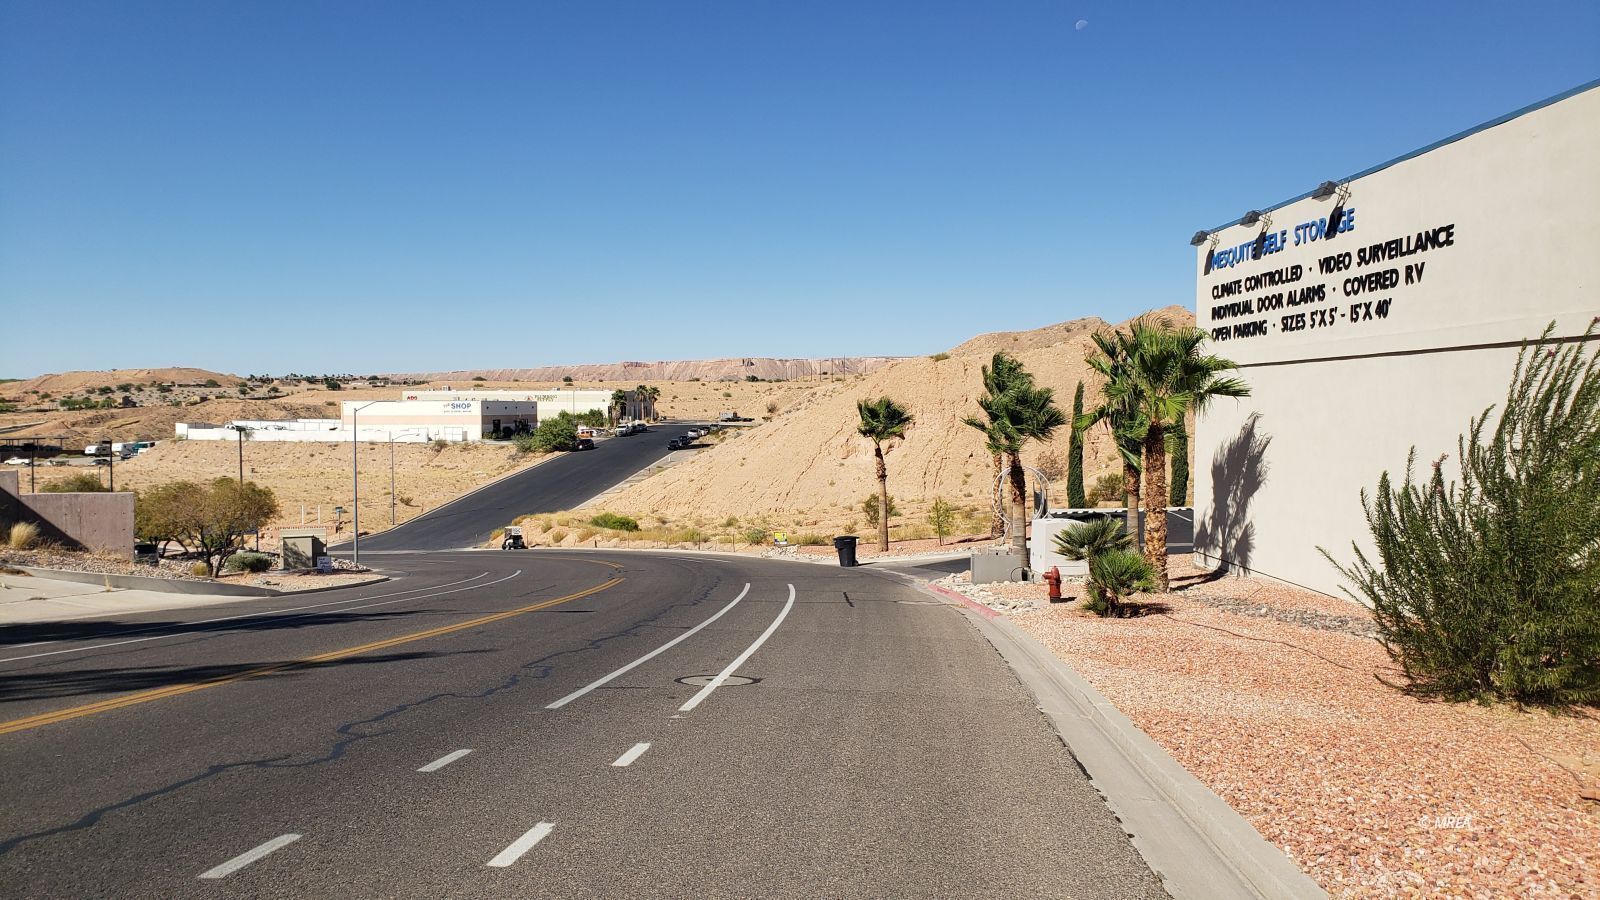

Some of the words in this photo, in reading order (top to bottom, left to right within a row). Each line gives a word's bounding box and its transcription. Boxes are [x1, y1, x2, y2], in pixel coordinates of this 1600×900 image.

[1212, 240, 1257, 271] MESQUITE
[1262, 230, 1287, 256] SELF
[1294, 208, 1355, 246] STORGE
[1212, 279, 1242, 300] CLIMATE
[1244, 264, 1303, 293] CONTROLLED
[1318, 252, 1352, 275] VIDEO
[1357, 224, 1455, 267] SURVEILLANCE
[1211, 299, 1254, 320] INDIVIDUAL
[1257, 293, 1284, 313] DOOR
[1287, 284, 1326, 307] ALARMS
[1343, 268, 1399, 297] COVERED
[1405, 262, 1425, 286] RV
[1211, 326, 1231, 342] OPEN
[1233, 320, 1268, 339] PARKING
[1281, 313, 1306, 333] SIZES
[451, 402, 472, 410] SHOP
